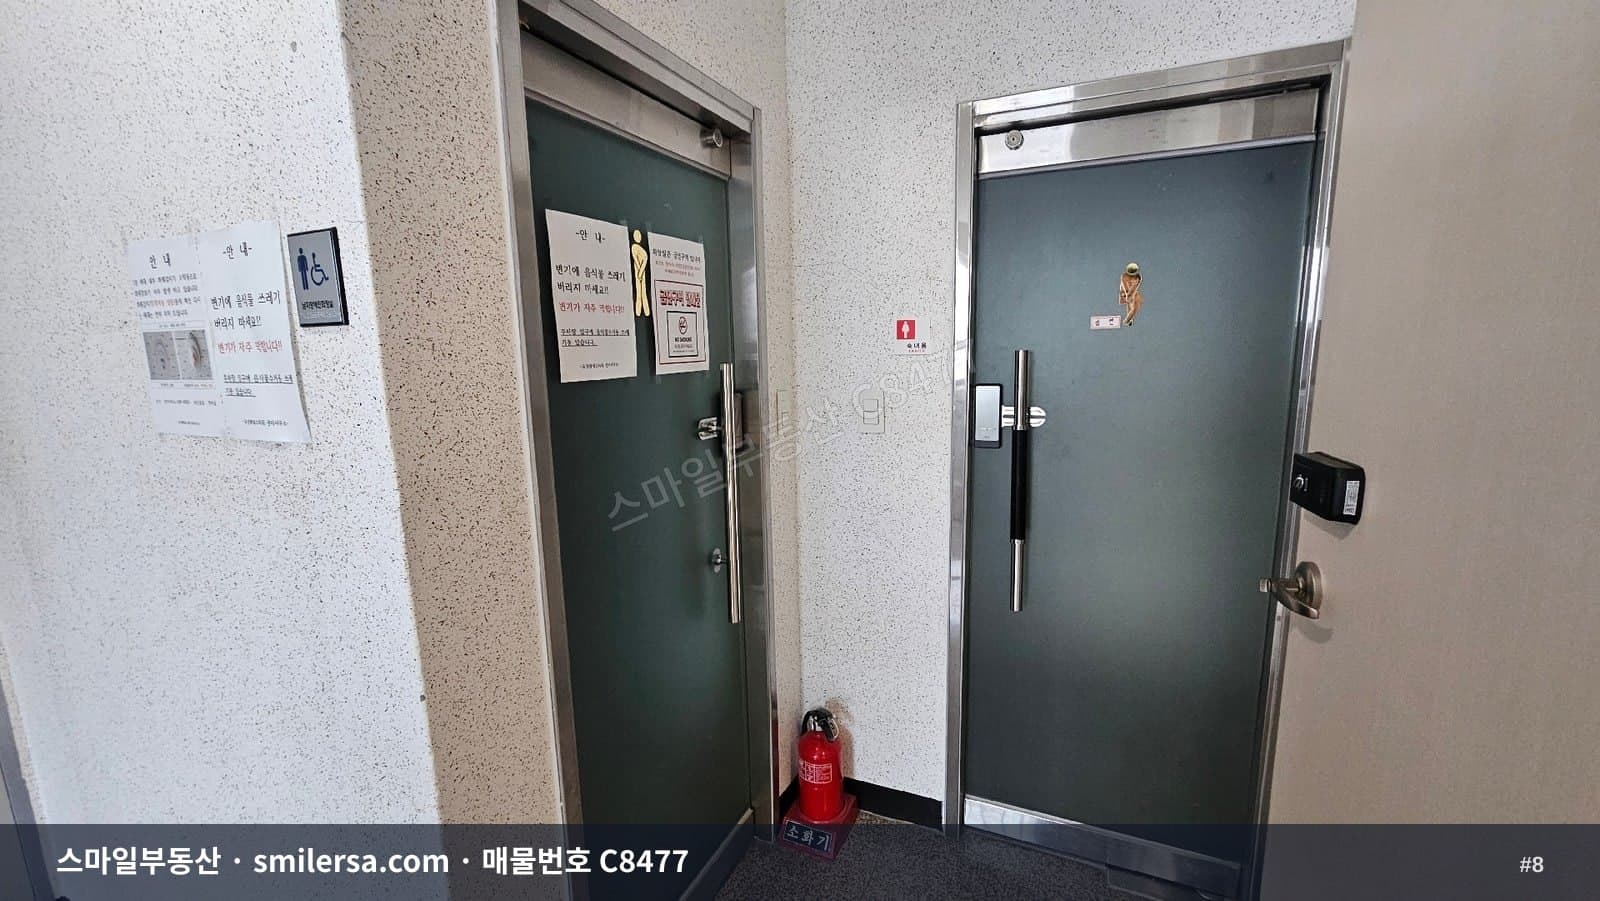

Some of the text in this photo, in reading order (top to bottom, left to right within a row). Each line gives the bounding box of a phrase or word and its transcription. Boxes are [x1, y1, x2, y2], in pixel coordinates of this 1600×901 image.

[556, 264, 580, 276] 변기에
[584, 267, 605, 279] 음식물
[557, 282, 581, 292] 버리지
[211, 296, 232, 310] 변기에
[235, 293, 254, 308] 음식물
[258, 290, 281, 304] 쓰레기
[560, 302, 580, 312] 변기가
[584, 303, 596, 313] 자주
[214, 316, 235, 329] 버리지
[218, 341, 236, 353] 변기가
[239, 341, 252, 352] 자주
[787, 825, 830, 851] 소화기
